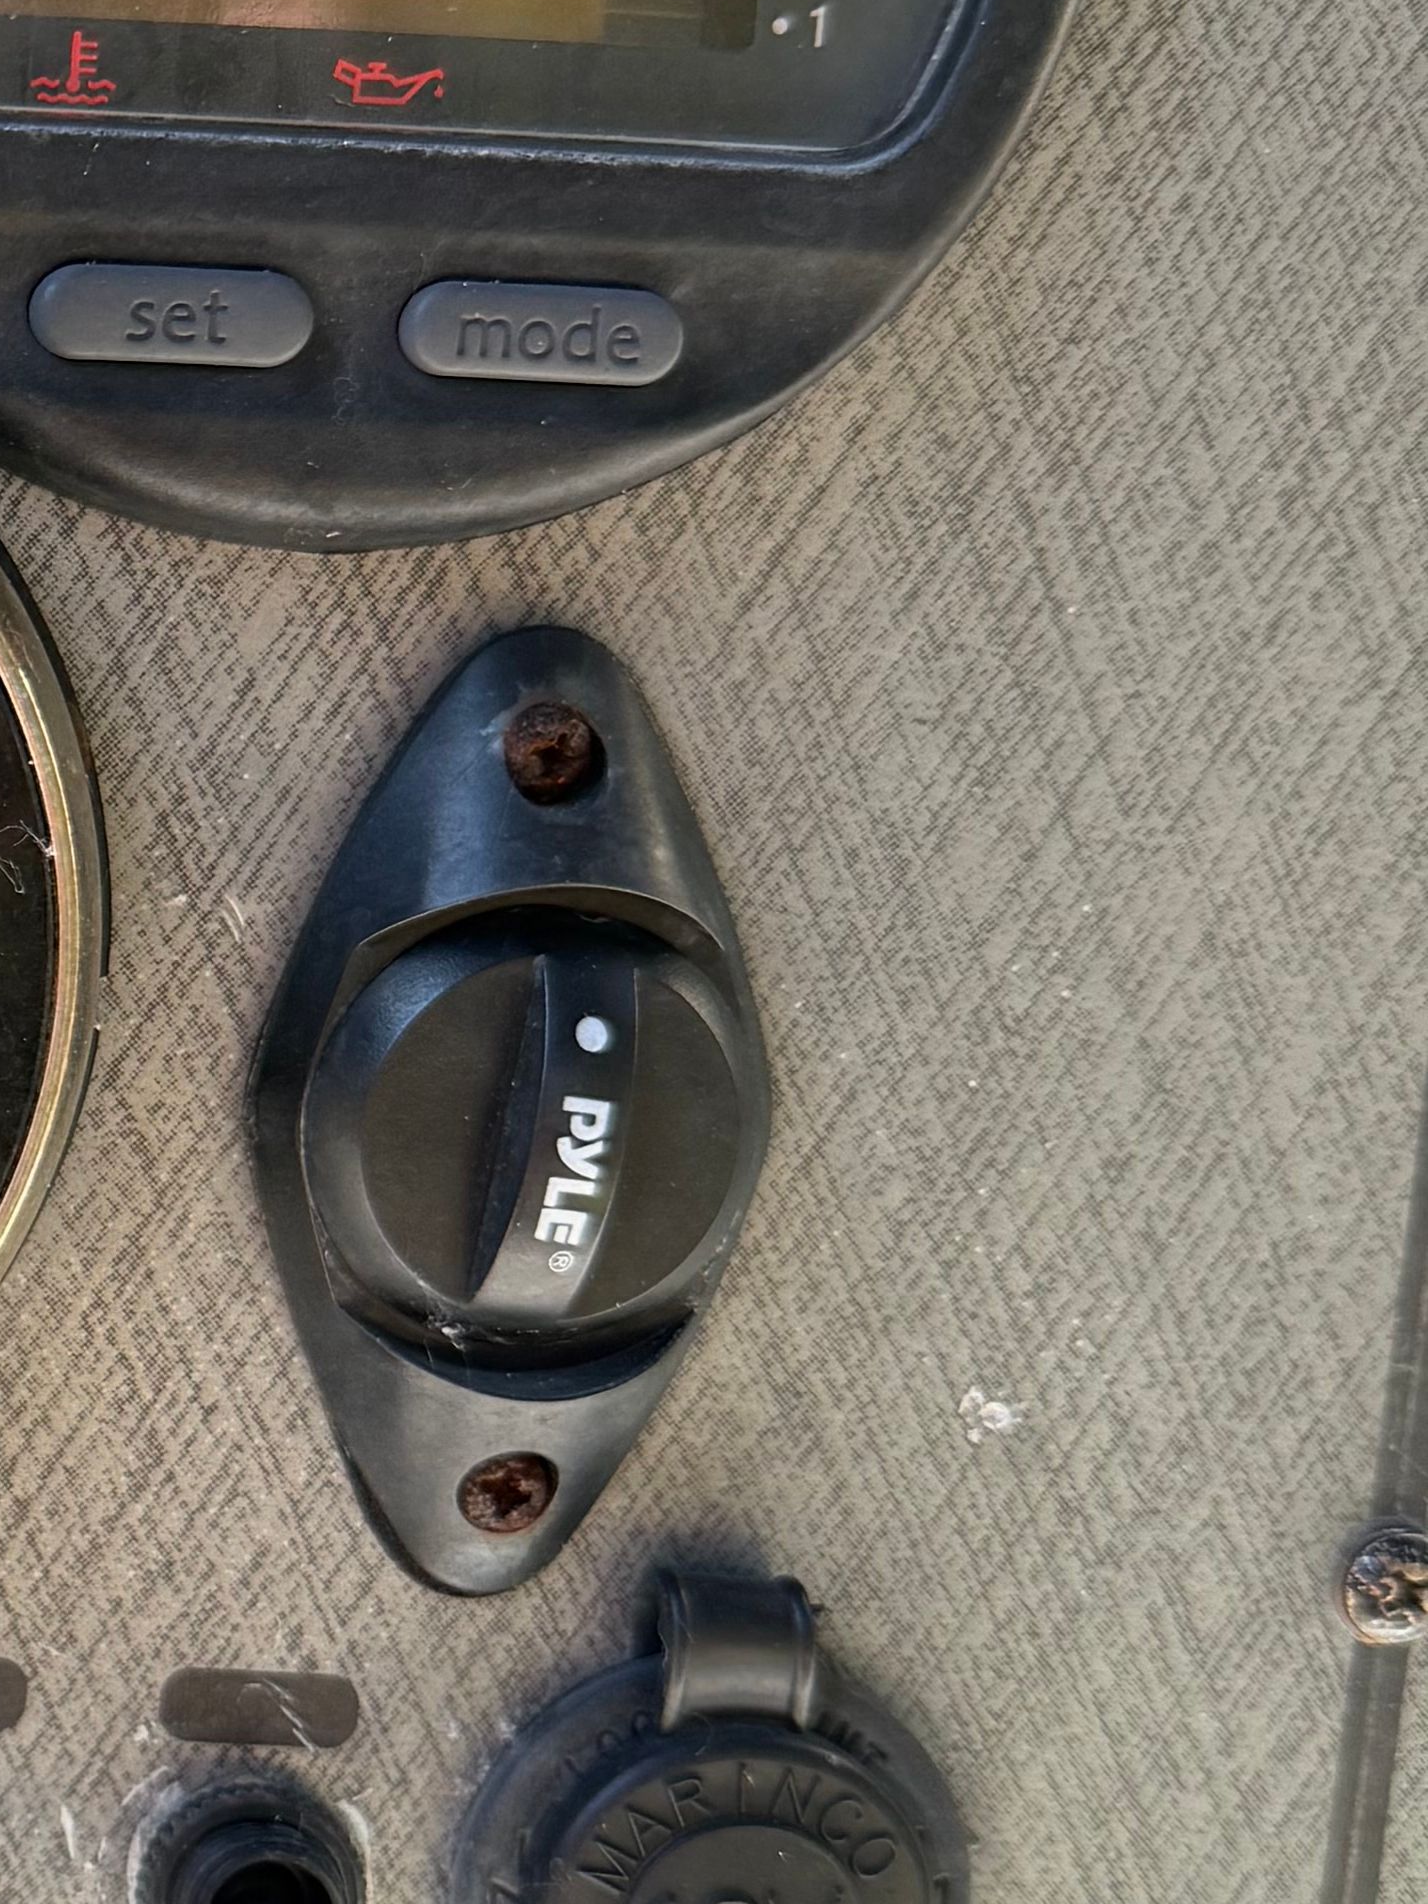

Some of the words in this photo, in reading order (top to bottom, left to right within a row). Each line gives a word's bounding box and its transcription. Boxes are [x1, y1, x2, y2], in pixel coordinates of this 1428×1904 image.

[807, 9, 827, 48] 1
[124, 289, 230, 346] set
[456, 304, 642, 365] mode
[532, 1095, 617, 1249] PYLE
[577, 1761, 899, 1895] MARINCO
